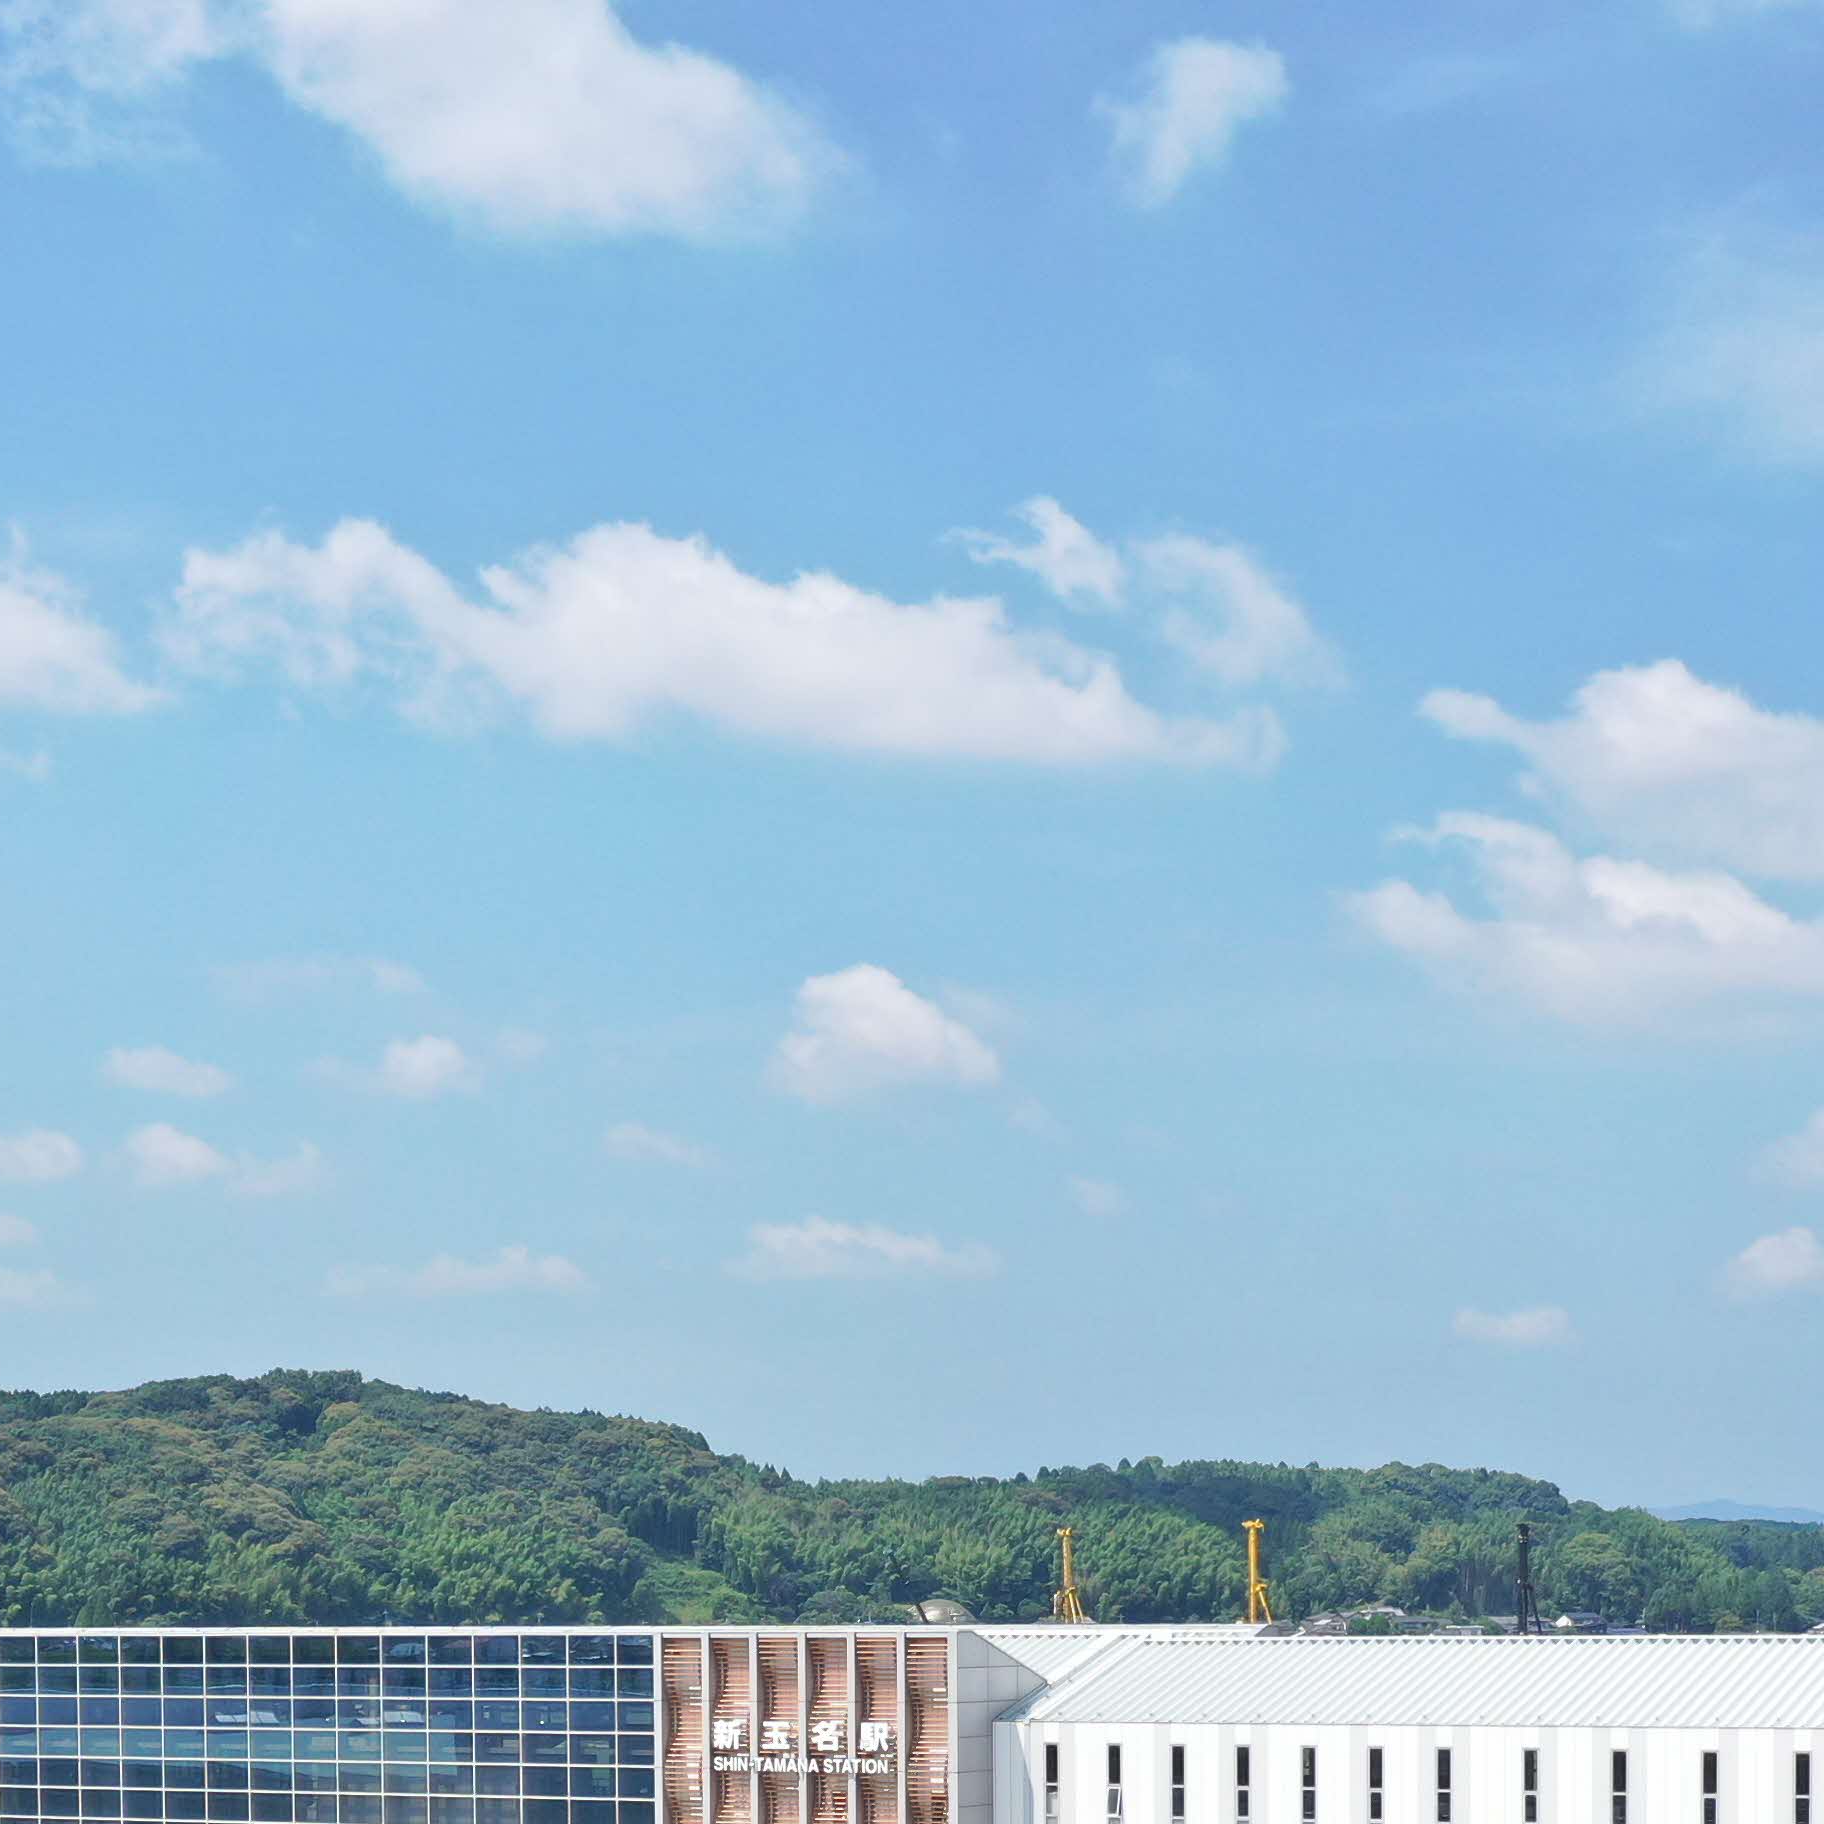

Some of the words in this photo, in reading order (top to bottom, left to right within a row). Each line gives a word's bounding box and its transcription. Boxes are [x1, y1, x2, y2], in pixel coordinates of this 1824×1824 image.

[713, 1719, 889, 1751] 新玉名駅
[714, 1756, 819, 1773] SHIN-TAMANA
[823, 1758, 889, 1774] STATION
